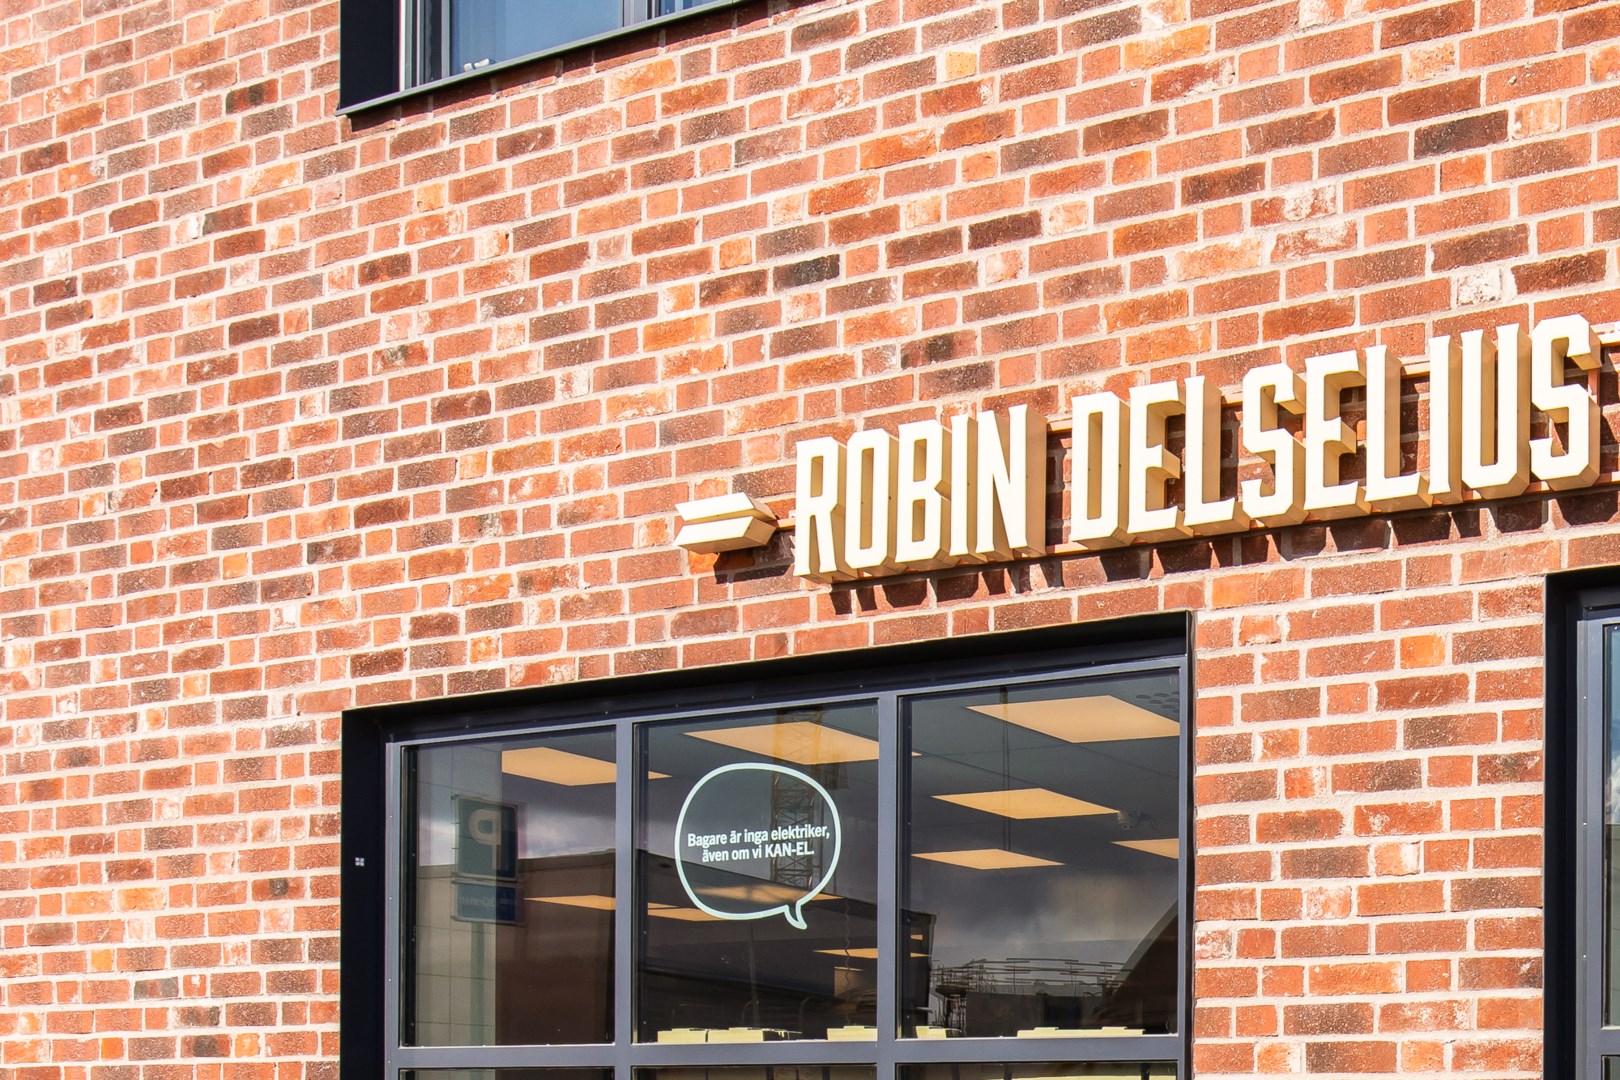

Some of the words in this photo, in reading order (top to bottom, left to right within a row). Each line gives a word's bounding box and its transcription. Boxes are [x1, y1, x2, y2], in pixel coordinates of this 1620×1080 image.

[793, 404, 1030, 577] ROBIN
[1069, 314, 1592, 542] DELSELIUS
[687, 833, 728, 849] Bagare
[730, 830, 742, 844] är
[744, 828, 769, 845] inga
[770, 824, 830, 841] elektriker,
[702, 849, 729, 863] även
[731, 848, 750, 861] om
[752, 845, 763, 859] vi
[764, 841, 815, 858] KAN-EL.
